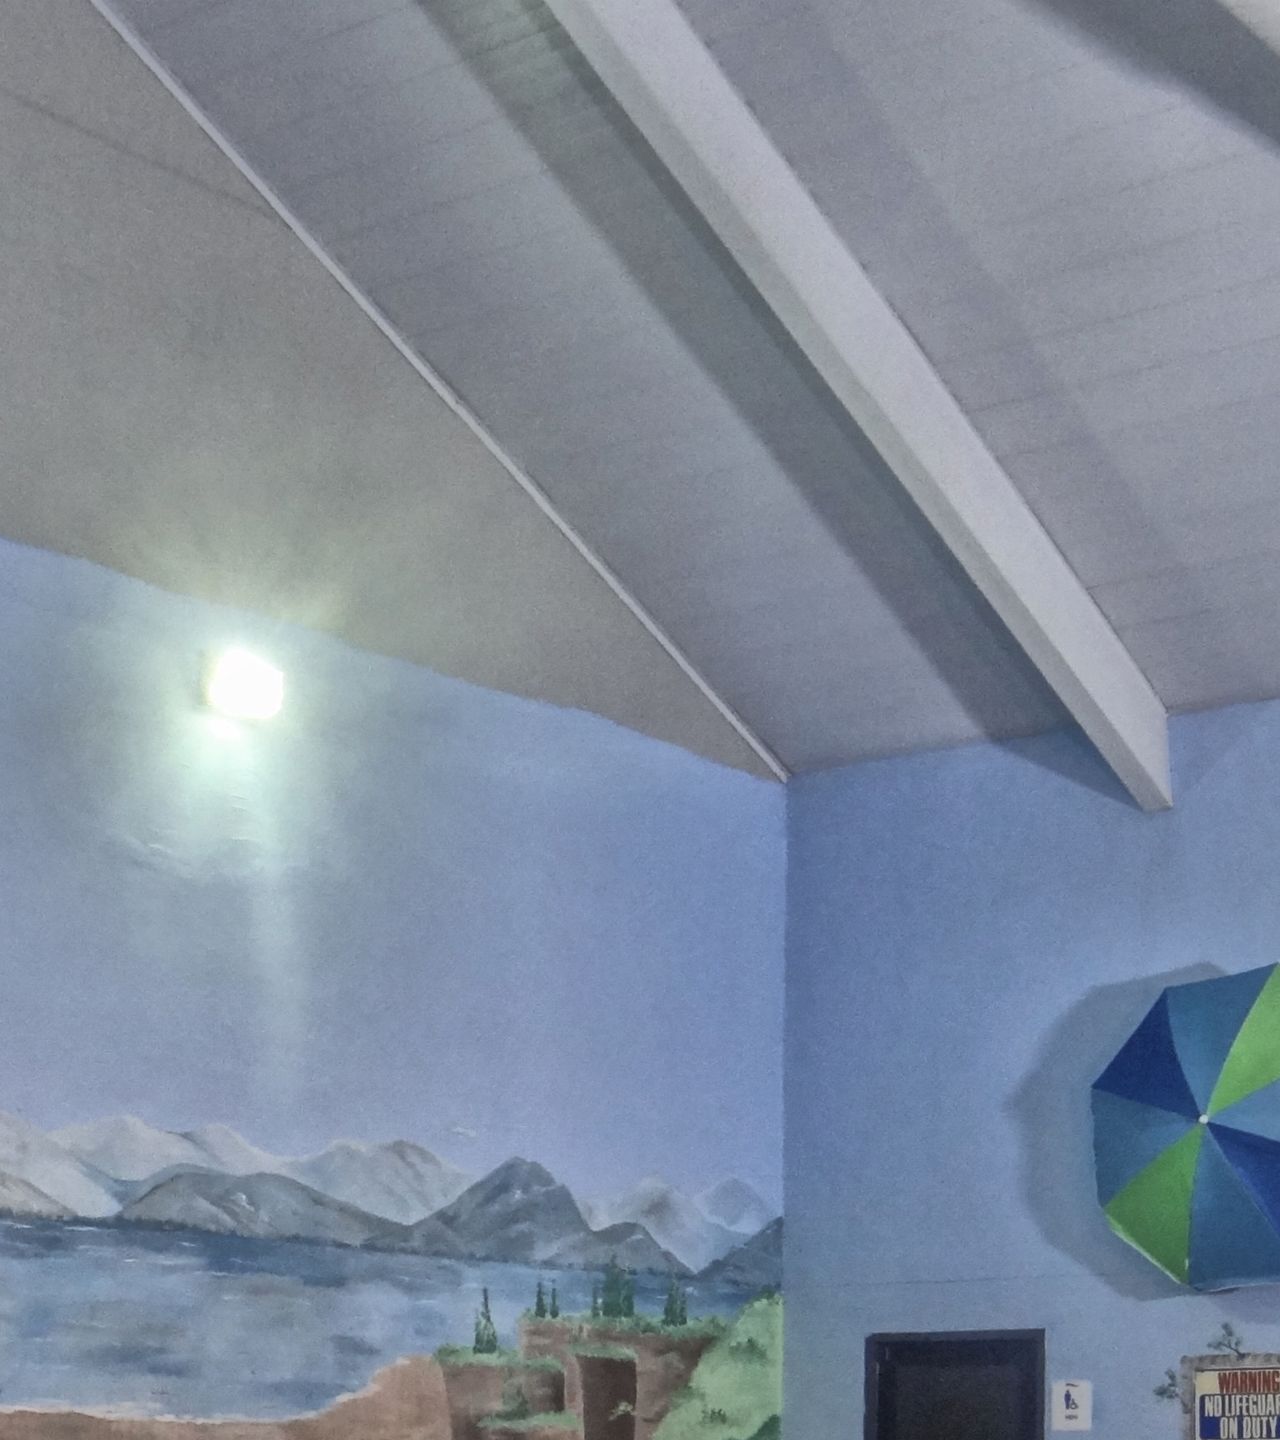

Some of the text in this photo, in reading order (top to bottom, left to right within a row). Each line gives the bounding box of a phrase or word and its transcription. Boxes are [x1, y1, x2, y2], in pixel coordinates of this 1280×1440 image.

[1218, 1371, 1280, 1393] WARNING
[1205, 1396, 1222, 1417] NO
[1221, 1416, 1278, 1439] ON DUTY
